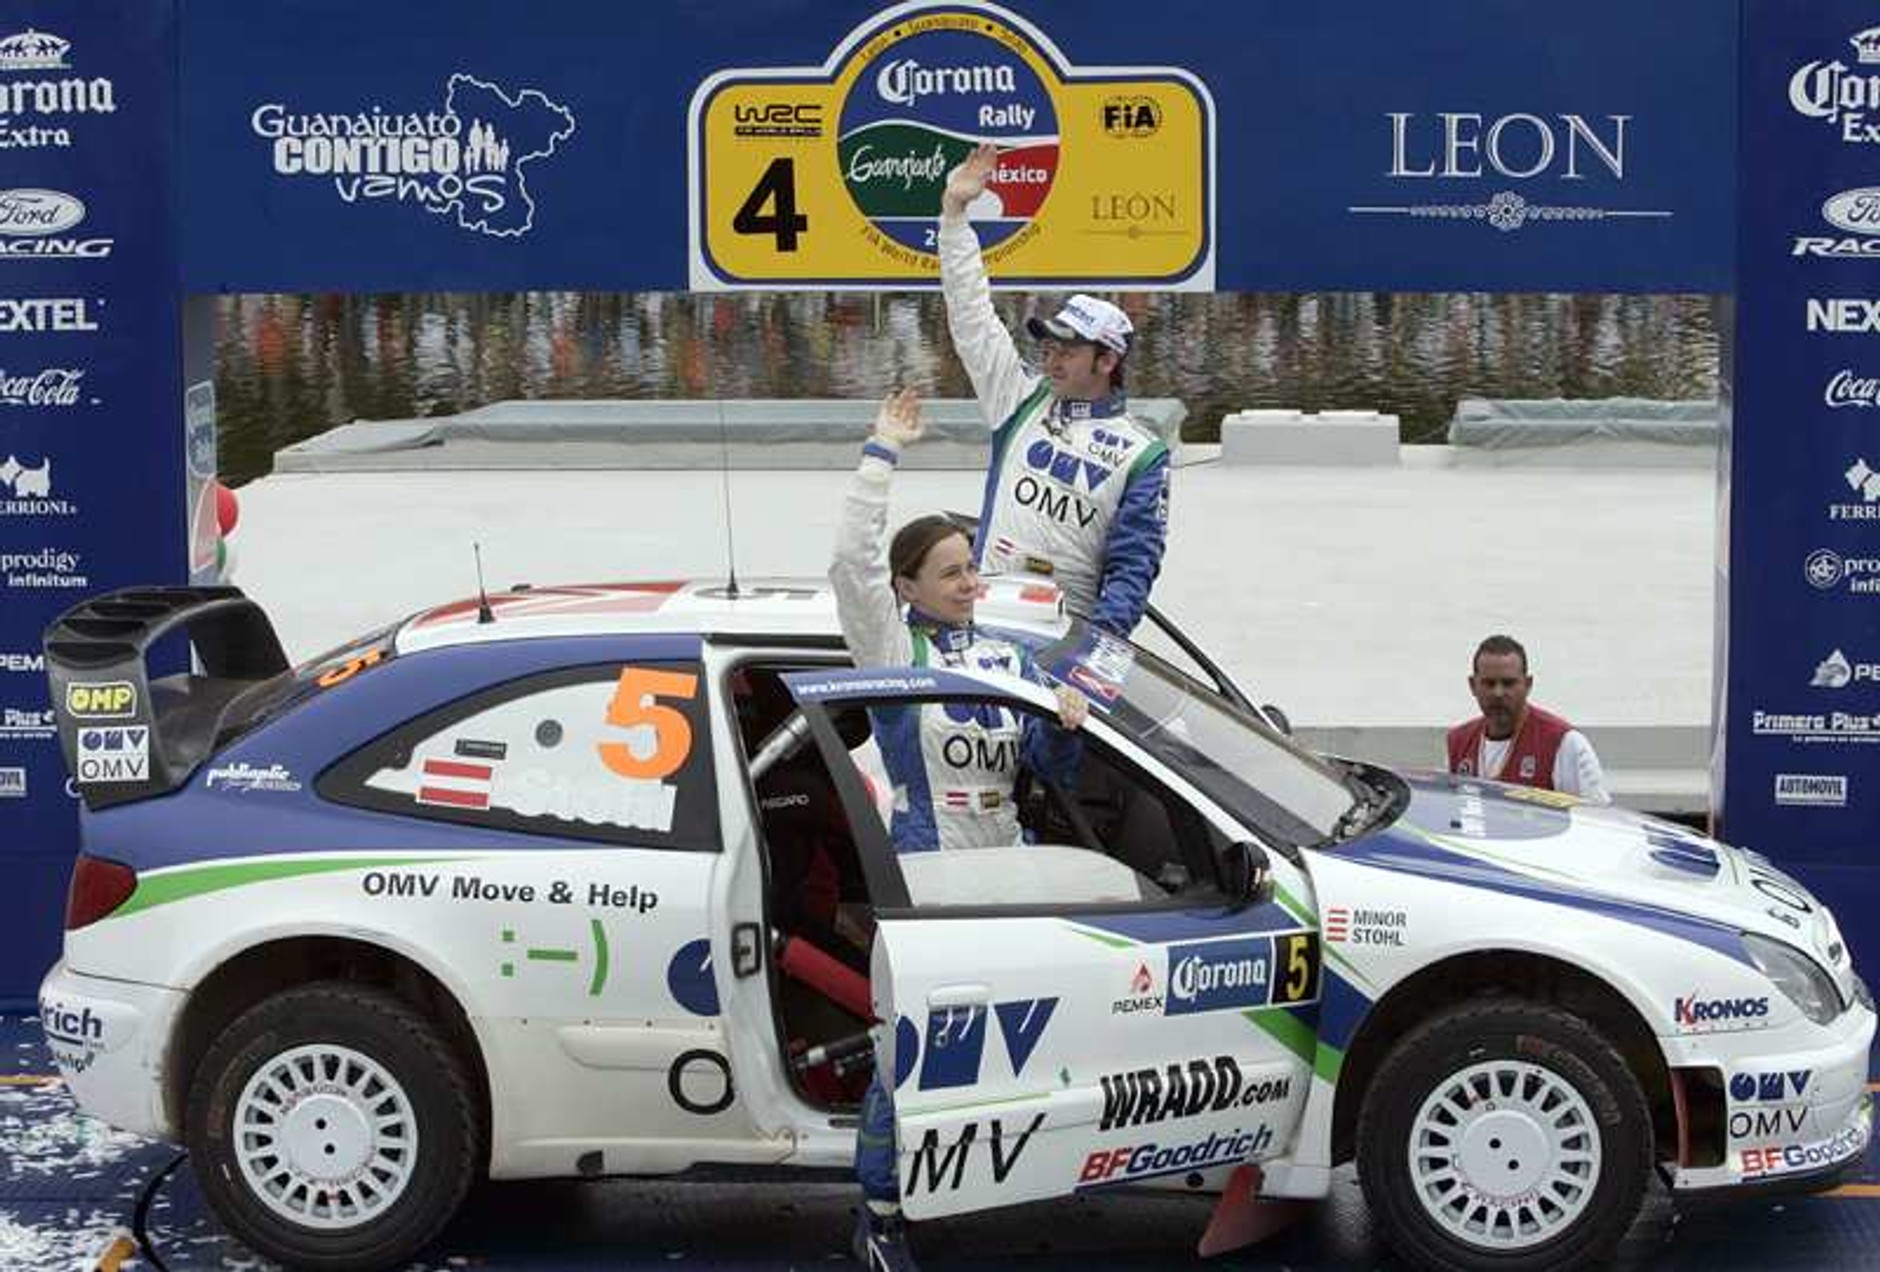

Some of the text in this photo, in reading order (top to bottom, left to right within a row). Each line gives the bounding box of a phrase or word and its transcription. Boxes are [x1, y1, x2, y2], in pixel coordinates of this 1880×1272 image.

[876, 59, 1016, 106] Corona
[252, 104, 462, 140] Guanajuato
[735, 104, 823, 124] WRC
[977, 105, 1036, 132] Rally
[274, 137, 460, 174] CONTIGO
[1384, 112, 1634, 180] LEON
[732, 157, 808, 253] 4
[1014, 476, 1098, 528] OMV
[2, 548, 79, 572] prodigy
[8, 572, 87, 587] infinitum
[71, 688, 132, 711] OMP
[596, 667, 697, 780] 5
[82, 758, 146, 779] OMV
[362, 872, 659, 913] OMV Move & Help
[1352, 909, 1408, 929] MINOR
[1352, 927, 1404, 947] STOHL
[1171, 935, 1309, 1002] Corona 5
[1112, 997, 1163, 1015] PEMEX
[1674, 995, 1769, 1025] KRONOS
[1729, 1106, 1809, 1139] OMV
[1080, 1123, 1273, 1184] BFGoodrich
